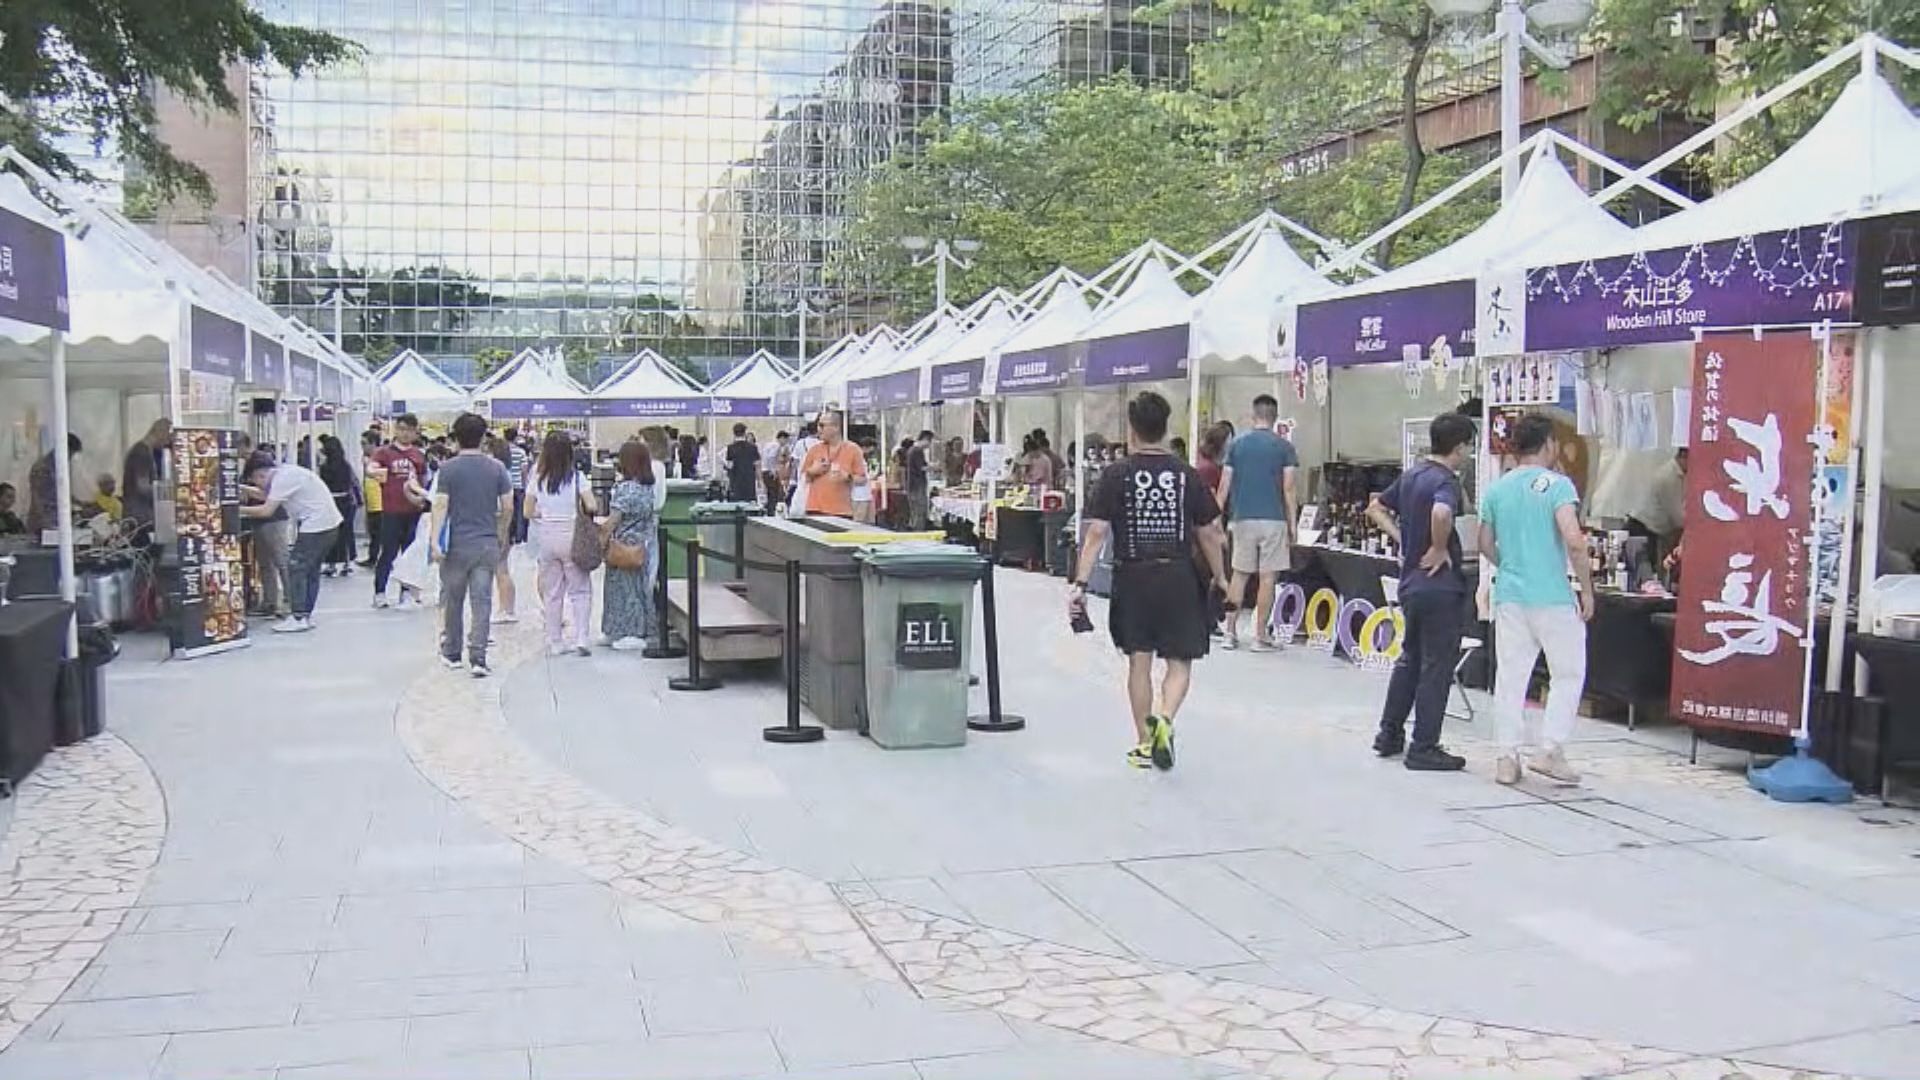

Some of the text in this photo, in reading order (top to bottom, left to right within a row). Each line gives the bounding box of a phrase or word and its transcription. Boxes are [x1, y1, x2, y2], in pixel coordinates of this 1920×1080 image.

[1622, 278, 1694, 308] 木山士多
[1812, 291, 1845, 311] A17
[1606, 312, 1652, 331] Wooden
[1675, 307, 1706, 325] Store
